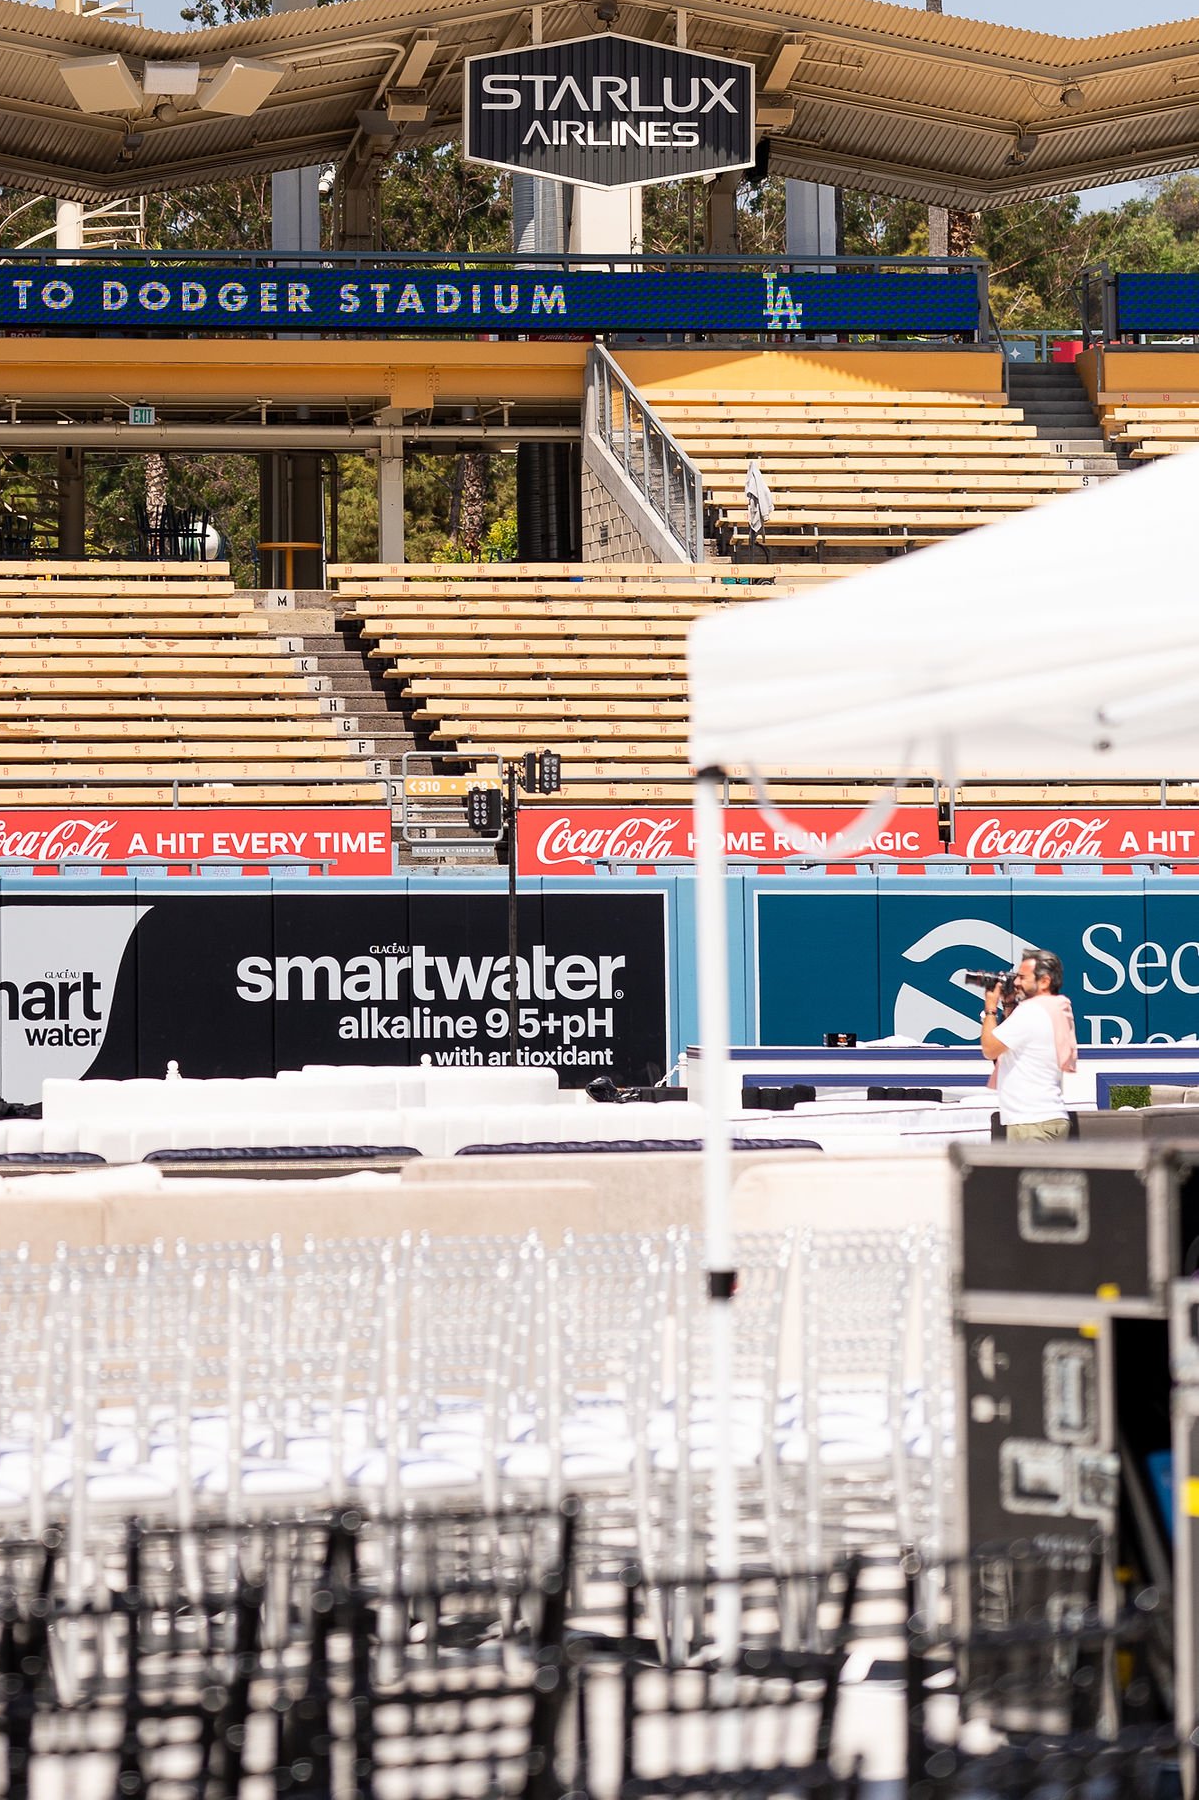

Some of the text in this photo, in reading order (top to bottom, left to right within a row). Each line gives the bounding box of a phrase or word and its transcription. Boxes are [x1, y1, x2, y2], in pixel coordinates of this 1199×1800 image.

[481, 73, 739, 114] STARLUX
[521, 120, 700, 148] AIRLINES
[13, 279, 74, 310] TO
[103, 280, 312, 313] DODGER
[340, 283, 567, 315] STADIUM
[763, 271, 803, 330] LA
[133, 408, 152, 424] EXIT
[1067, 460, 1074, 470] T
[1082, 476, 1089, 487] S
[277, 595, 287, 607] M
[288, 640, 296, 652] L
[301, 659, 308, 671] K
[314, 680, 322, 692] J
[329, 699, 337, 711] H
[343, 720, 351, 732] G
[358, 741, 366, 753] F
[374, 763, 382, 775] E
[418, 781, 440, 792] 310
[128, 833, 148, 853] A
[157, 833, 204, 853] HIT
[212, 833, 308, 854] EVERY
[314, 833, 386, 853] TIME
[537, 818, 681, 866] Coca-Cola
[965, 818, 1196, 858] Coca-Cola A HIT
[236, 944, 626, 1002] smartwater
[338, 1007, 614, 1045] alkaline 95+pH
[24, 1025, 99, 1047] water
[434, 1046, 484, 1066] with
